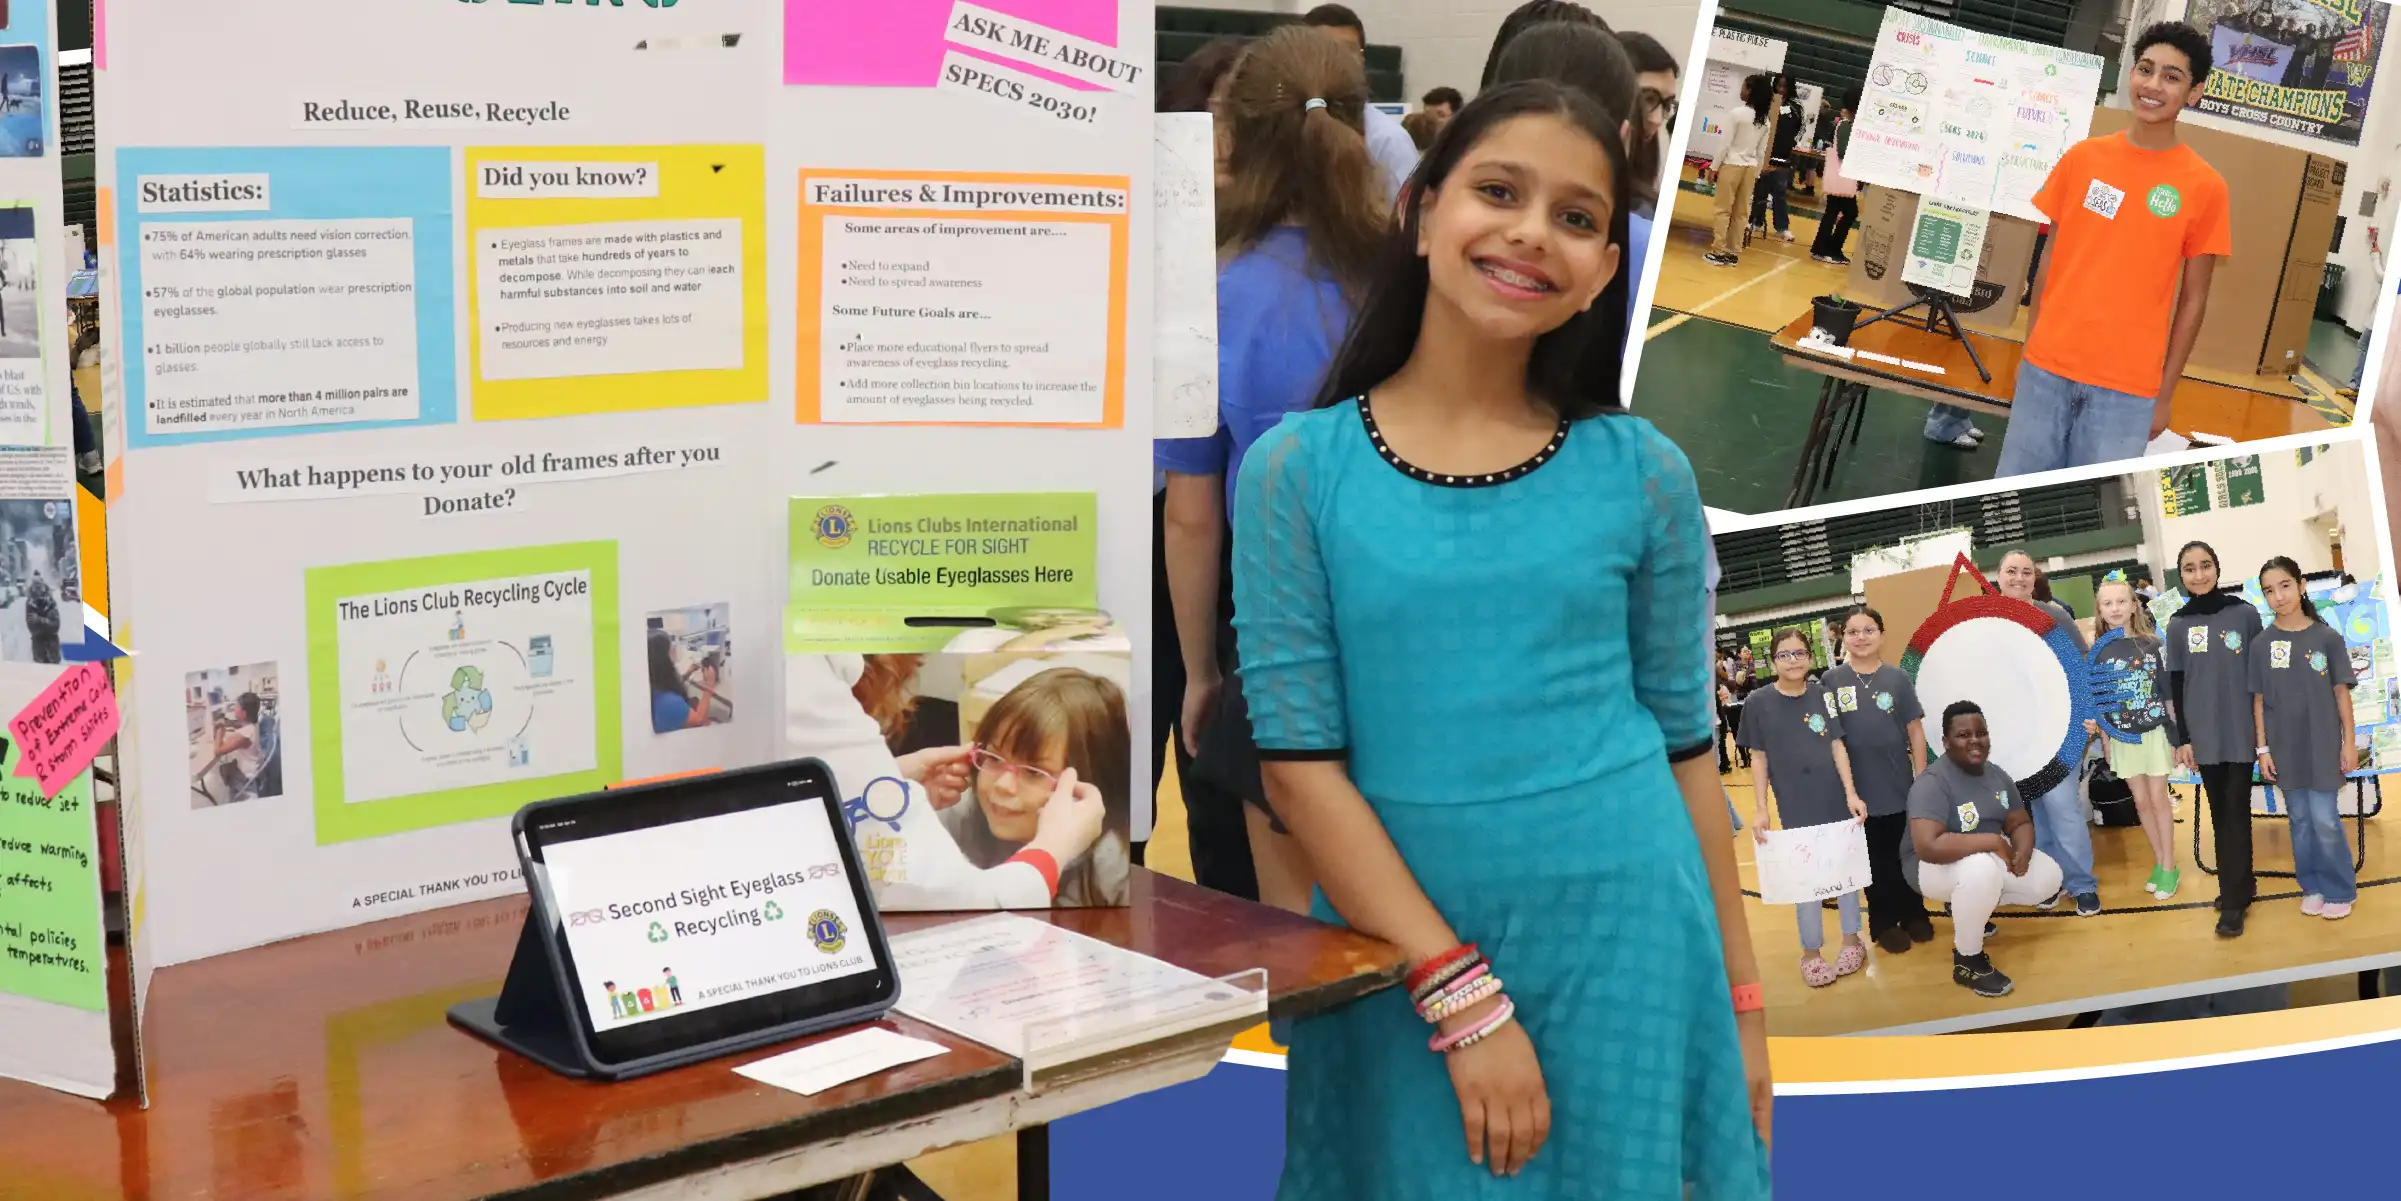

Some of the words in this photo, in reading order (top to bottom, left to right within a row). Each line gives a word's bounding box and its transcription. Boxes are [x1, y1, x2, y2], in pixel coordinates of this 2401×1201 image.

[952, 13, 1005, 43] ASK
[1008, 29, 1050, 56] ME
[1054, 46, 1143, 84] ABOUT
[945, 64, 1025, 101] SPECS
[1028, 92, 1097, 124] 2030!
[2247, 81, 2347, 123] CHAMPIONS
[304, 99, 397, 123] Reduce,
[404, 99, 480, 120] Reuse,
[486, 101, 569, 126] Recycle
[2200, 98, 2230, 117] BOYS
[2232, 106, 2268, 123] CROSS
[2270, 115, 2324, 134] COUNTRY
[484, 166, 523, 186] Did
[529, 172, 569, 191] you
[576, 166, 646, 186] know?
[143, 179, 262, 203] Statistics:
[815, 184, 912, 203] Failures
[919, 183, 936, 203] &
[943, 185, 1123, 212] Improvements:
[152, 230, 178, 242] 75%
[181, 231, 193, 242] of
[196, 230, 249, 242] American
[253, 230, 287, 242] adults
[290, 228, 317, 240] need
[320, 228, 351, 240] vision
[501, 238, 546, 253] Eyeglass
[548, 236, 583, 248] frames
[586, 236, 601, 245] are
[604, 233, 633, 244] made
[635, 232, 657, 243] with
[660, 230, 700, 244] plastics
[703, 229, 722, 240] and
[845, 222, 882, 233] Some
[885, 226, 920, 234] areas
[922, 222, 937, 234] of
[939, 223, 1026, 238] improvement
[180, 248, 206, 261] 64%
[209, 248, 254, 262] wearing
[257, 248, 322, 261] prescription
[326, 246, 366, 260] glasses
[499, 254, 534, 267] metals
[537, 254, 556, 264] that
[559, 253, 579, 263] take
[582, 249, 631, 262] hundreds
[634, 248, 645, 259] of
[647, 249, 676, 262] years
[679, 247, 689, 257] to
[567, 268, 594, 281] While
[598, 268, 662, 280] decomposing
[664, 266, 685, 278] they
[687, 266, 705, 277] can
[708, 263, 734, 275] leach
[848, 275, 875, 287] Need
[879, 277, 889, 287] to
[891, 276, 926, 289] spread
[929, 279, 982, 288] awareness
[500, 287, 541, 300] harmful
[544, 285, 603, 298] substances
[607, 284, 627, 295] into
[630, 282, 648, 294] soil
[651, 282, 670, 293] and
[833, 304, 868, 316] Some
[872, 306, 915, 318] Future
[919, 306, 955, 319] Goals
[154, 399, 165, 410] It
[168, 397, 176, 409] is
[180, 394, 232, 409] estimated
[235, 394, 254, 405] that
[258, 394, 286, 403] more
[288, 390, 312, 402] than
[315, 390, 322, 401] 4
[325, 388, 361, 401] million
[363, 387, 389, 401] pairs
[391, 387, 408, 398] are
[236, 467, 301, 490] What
[308, 465, 405, 490] happens
[412, 463, 434, 481] to
[440, 463, 493, 484] your
[501, 453, 535, 476] old
[542, 452, 618, 473] frames
[624, 446, 675, 467] after
[681, 447, 719, 468] you
[424, 487, 515, 516] Donate?
[829, 519, 840, 535] L
[868, 518, 912, 534] Lions
[917, 516, 962, 533] Clubs
[966, 515, 1077, 533] International
[868, 538, 940, 557] RECYCLE
[946, 538, 976, 556] FOR
[982, 537, 1029, 555] SIGHT
[813, 568, 870, 586] Donate
[876, 567, 930, 585] Usable
[937, 566, 1029, 588] Eyeglasses
[1035, 565, 1073, 583] Here
[339, 601, 369, 621] The
[375, 597, 418, 617] Lions
[422, 590, 461, 611] Club
[464, 582, 540, 609] Recycling
[544, 576, 587, 602] Cycle
[17, 668, 91, 741] Prevention
[28, 738, 41, 762] of
[45, 700, 88, 746] Extreme
[16, 792, 51, 810] reduce
[59, 795, 80, 812] jet
[41, 844, 88, 868] warming
[7, 873, 53, 892] affects
[353, 897, 362, 908] A
[364, 888, 415, 906] SPECIAL
[418, 879, 460, 896] THANK
[463, 874, 488, 888] YOU
[492, 870, 508, 883] TO
[608, 892, 678, 920] Second
[680, 884, 727, 907] Sight
[730, 870, 805, 897] Eyeglass
[674, 907, 762, 938] Recycling
[821, 923, 836, 941] L
[30, 928, 77, 950] policies
[7, 946, 90, 973] temperatures.
